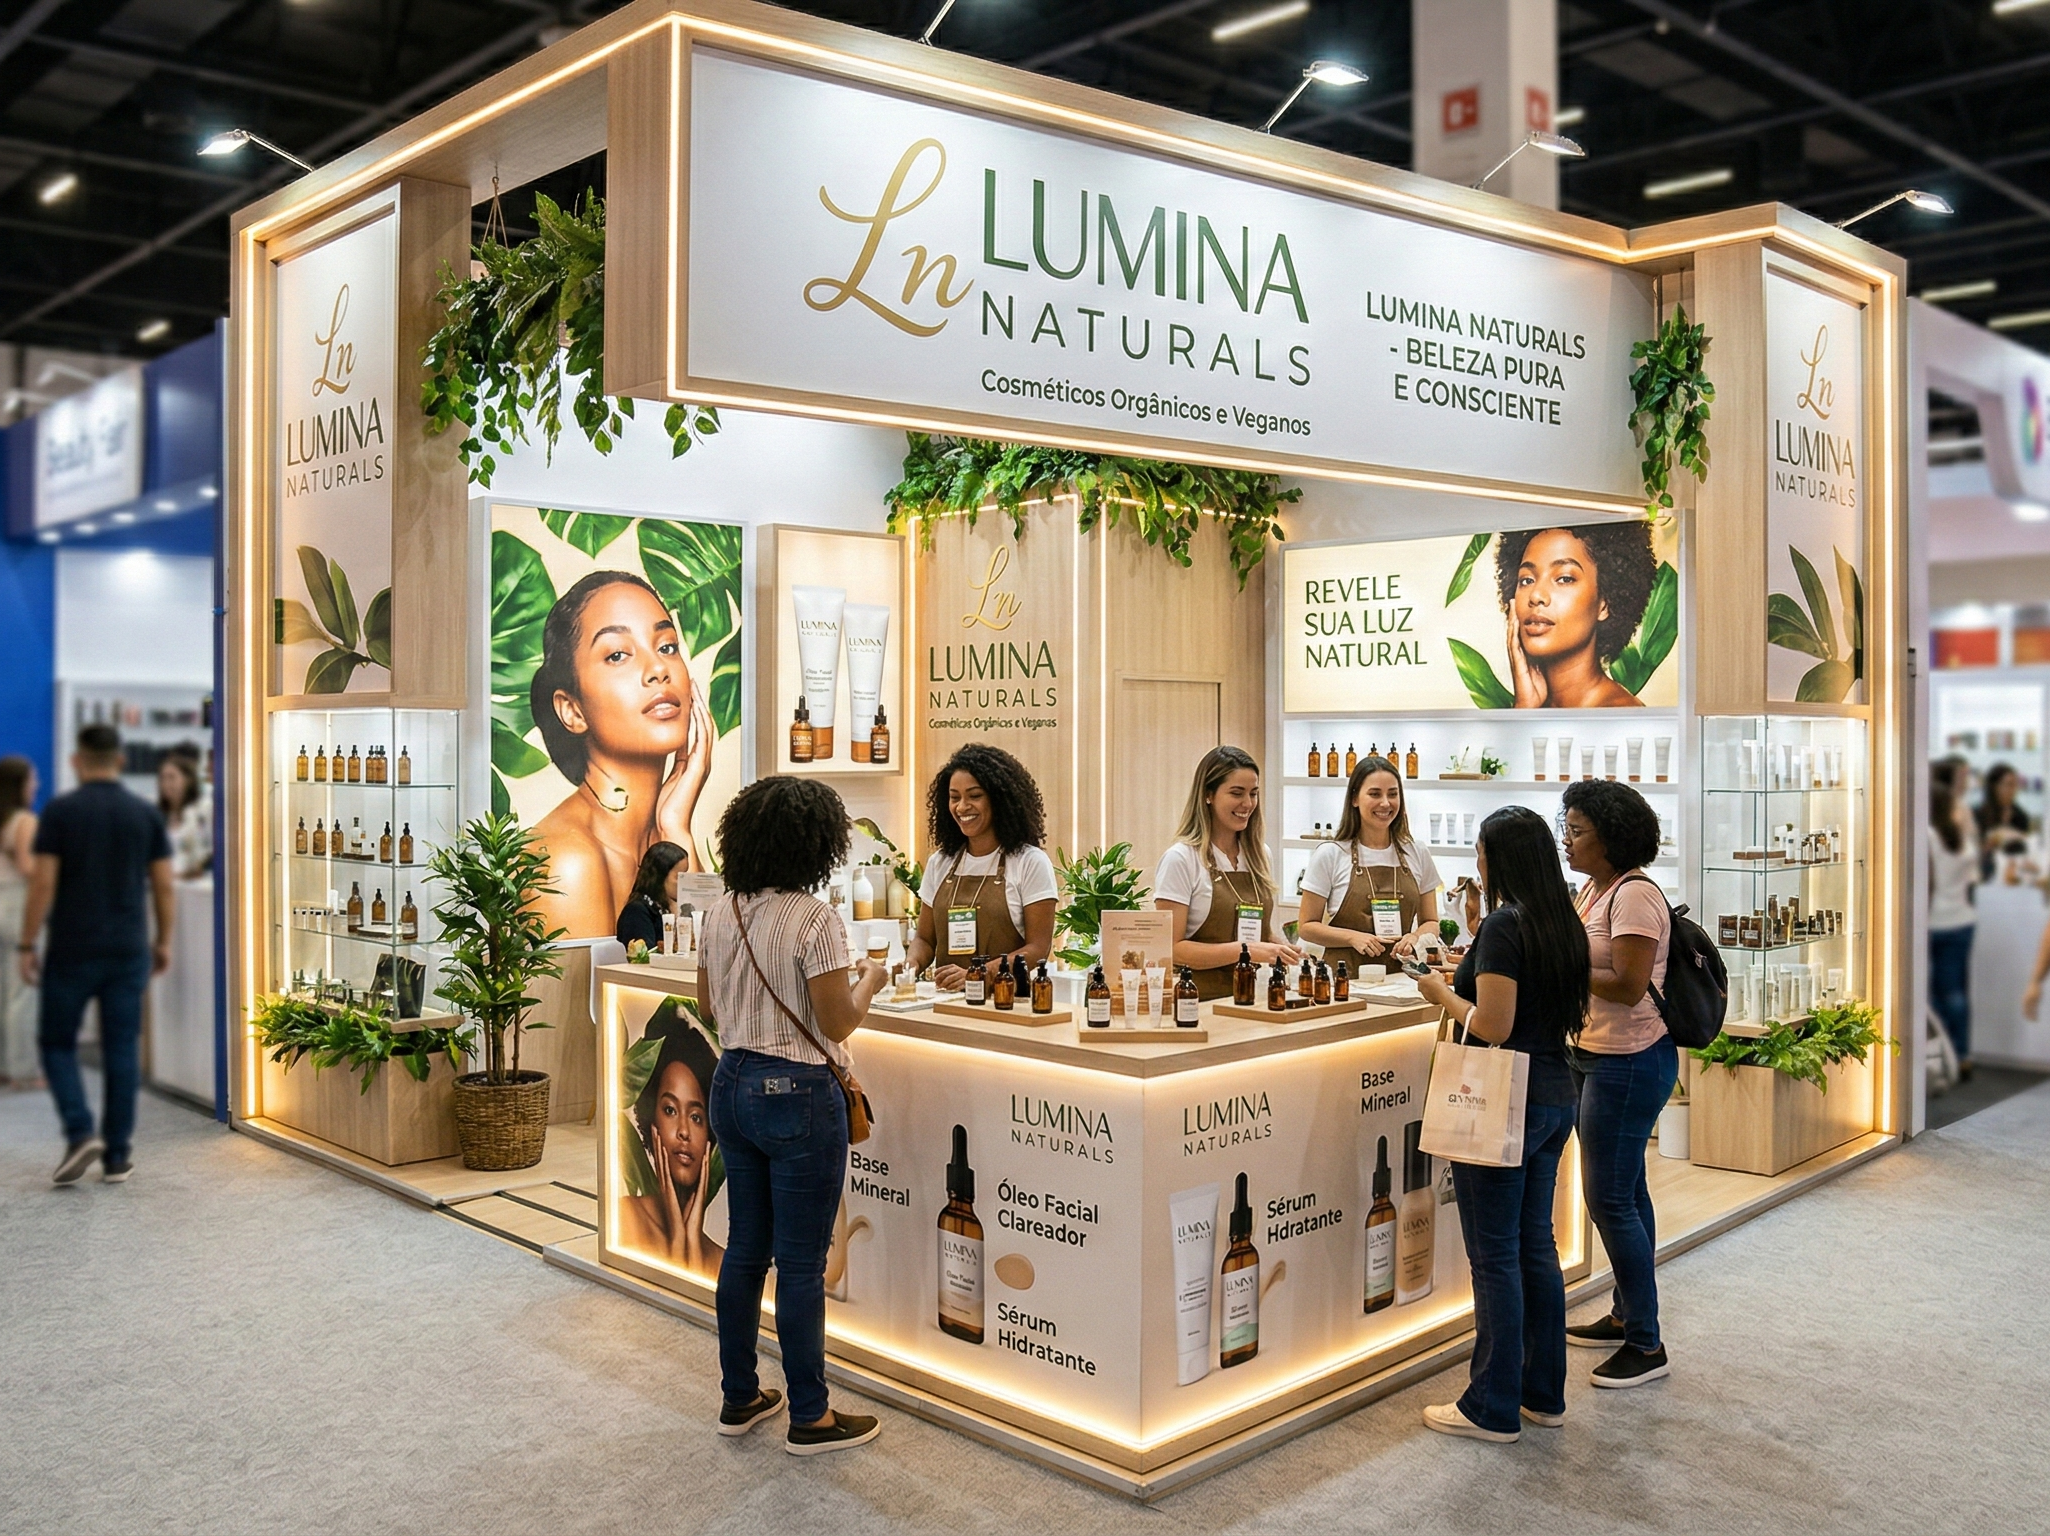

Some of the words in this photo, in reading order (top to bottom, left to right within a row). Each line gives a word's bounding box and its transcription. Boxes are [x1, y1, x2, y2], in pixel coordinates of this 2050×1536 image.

[984, 168, 1309, 324] LUMINA
[982, 291, 1311, 386] NATURALS
[1366, 291, 1463, 335] LUMINA
[1470, 312, 1586, 359] NATURALS
[1407, 337, 1497, 379] BELEZA
[1504, 356, 1565, 391] PURA
[981, 368, 1106, 408] Cosméticos
[1113, 388, 1211, 425] Orgânicos
[1217, 406, 1229, 425] e
[1232, 405, 1311, 436] Veganos
[1394, 374, 1408, 400] E
[1416, 377, 1561, 426] CONSCIENTE
[287, 397, 384, 466] LUMINA
[1775, 419, 1855, 479] LUMINA
[286, 455, 384, 498] NATURALS
[1776, 471, 1856, 508] NATURALS
[1305, 574, 1401, 605] REVELE
[1304, 611, 1355, 636] SUA
[1363, 607, 1413, 634] LUZ
[930, 640, 1057, 682] LUMINA
[1305, 641, 1428, 669] NATURAL
[930, 687, 1057, 709] NATURALS
[1361, 1070, 1395, 1090] Base
[1011, 1094, 1113, 1144] LUMINA
[1183, 1091, 1272, 1136] LUMINA
[1361, 1086, 1411, 1115] Mineral
[1011, 1129, 1114, 1164] NATURALS
[1183, 1124, 1272, 1157] NATURALS
[850, 1151, 889, 1176] Base
[850, 1175, 910, 1207] Mineral
[997, 1178, 1039, 1209] Óleo
[1044, 1193, 1099, 1225] Facial
[1267, 1192, 1316, 1219] Sérum
[997, 1209, 1087, 1248] Clareador
[1267, 1209, 1343, 1244] Hdratante
[997, 1302, 1057, 1337] Sérum
[998, 1329, 1097, 1376] Hidratante
